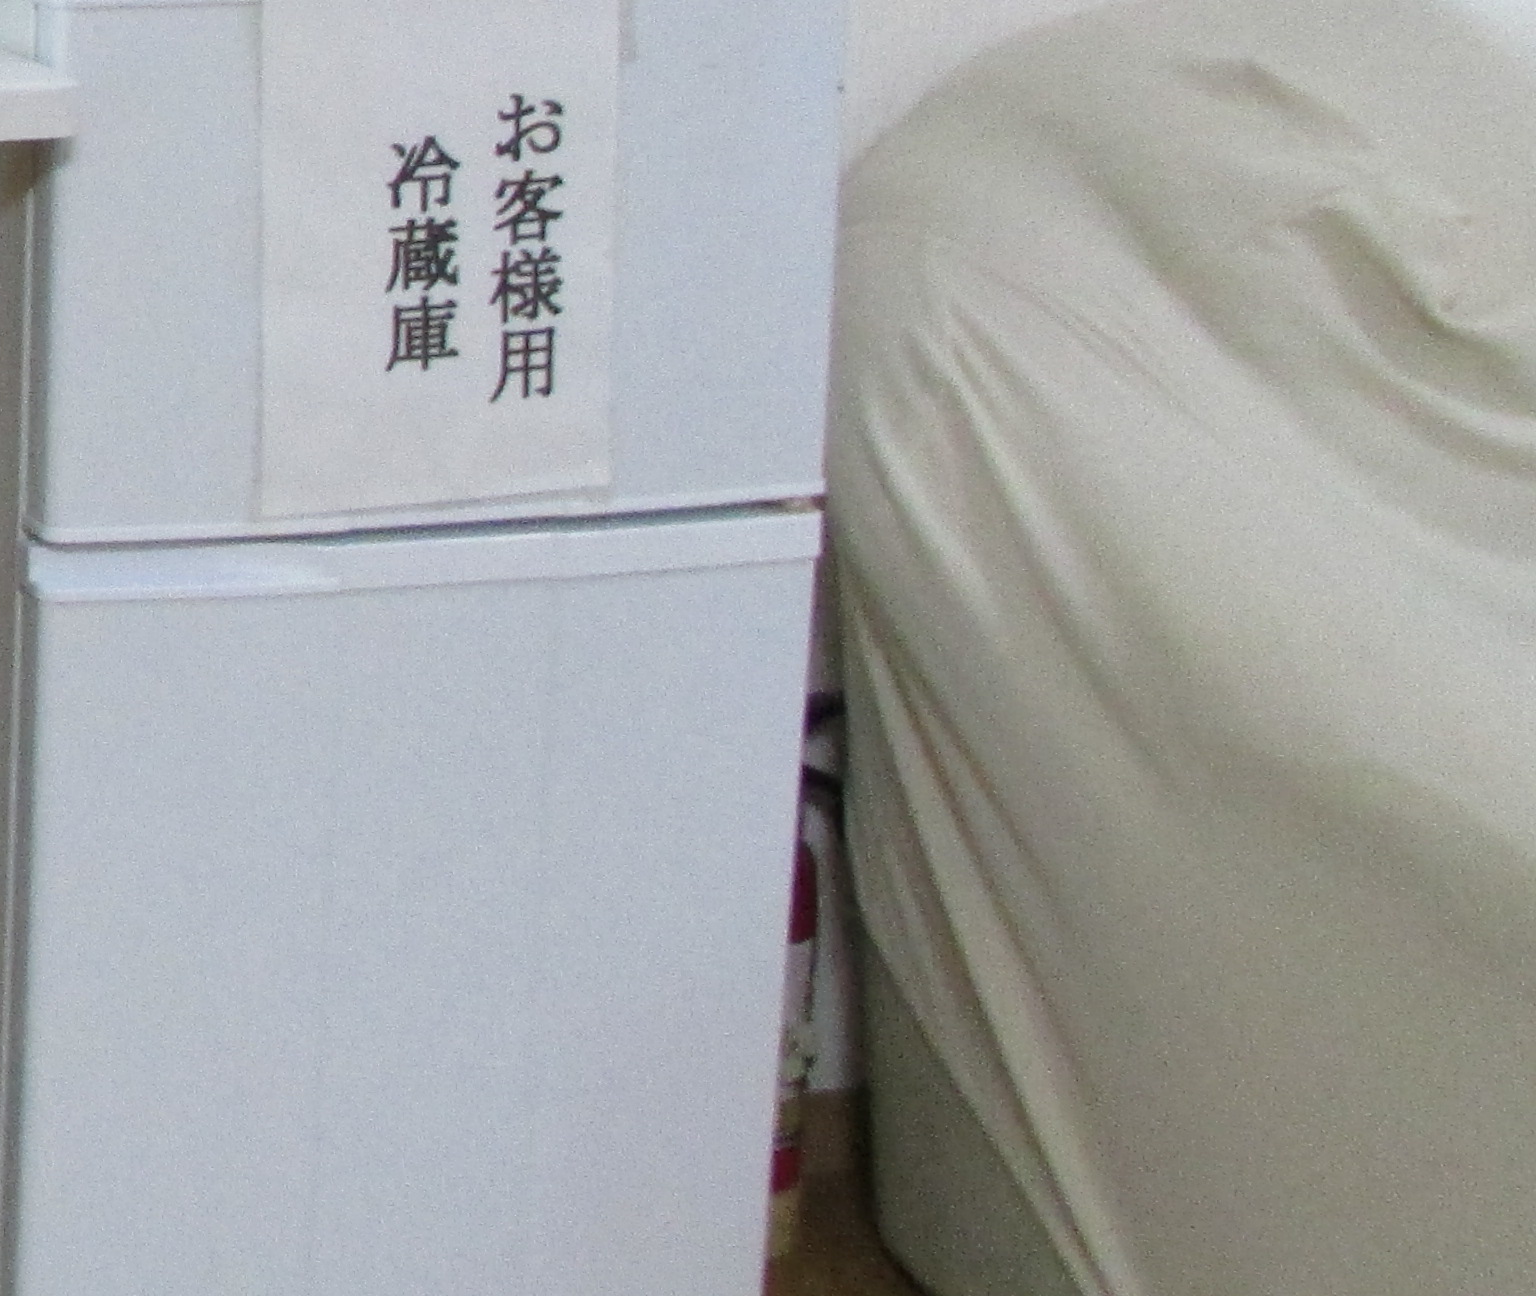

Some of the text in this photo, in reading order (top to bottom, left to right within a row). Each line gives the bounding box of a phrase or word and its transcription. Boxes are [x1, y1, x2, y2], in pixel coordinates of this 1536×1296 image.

[384, 135, 461, 372] 冷蔵庫
[489, 94, 565, 403] お客様用
